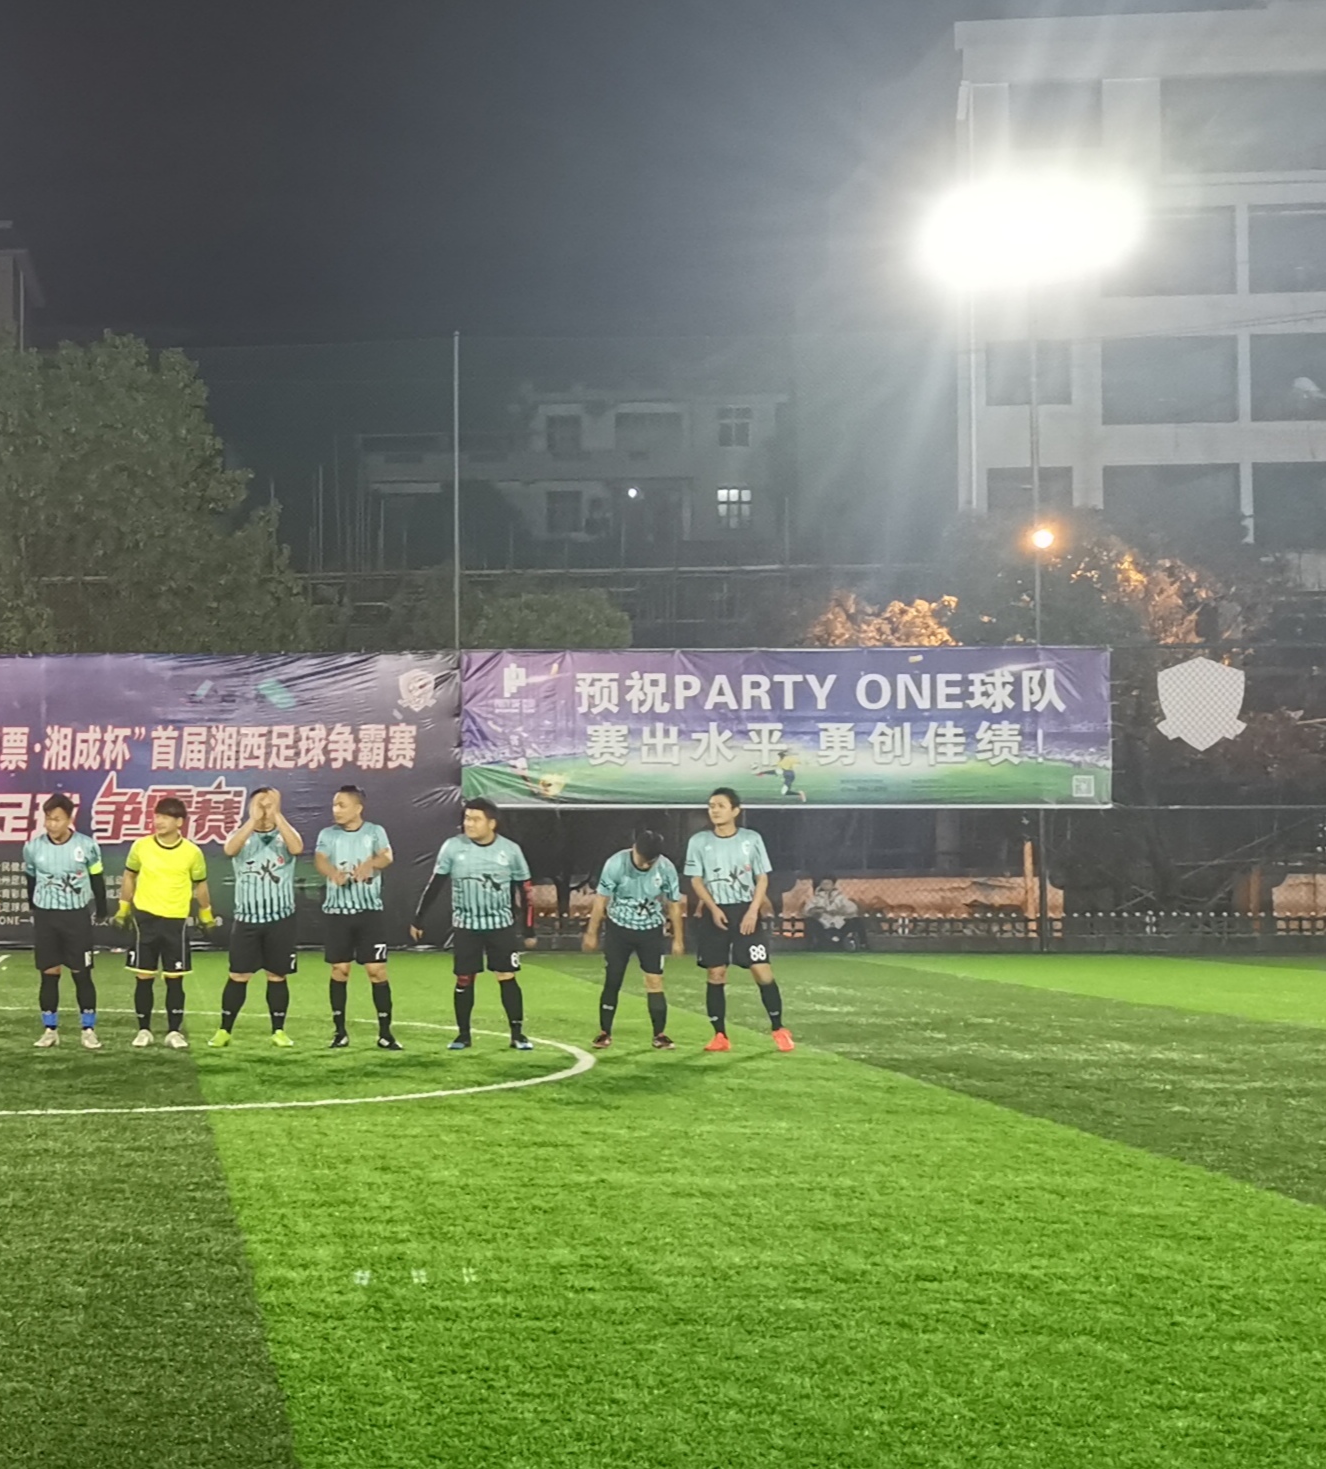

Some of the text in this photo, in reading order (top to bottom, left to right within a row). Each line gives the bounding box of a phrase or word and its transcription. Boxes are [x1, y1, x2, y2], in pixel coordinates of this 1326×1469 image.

[585, 721, 789, 767] 赛出水平
[749, 944, 767, 961] 88
